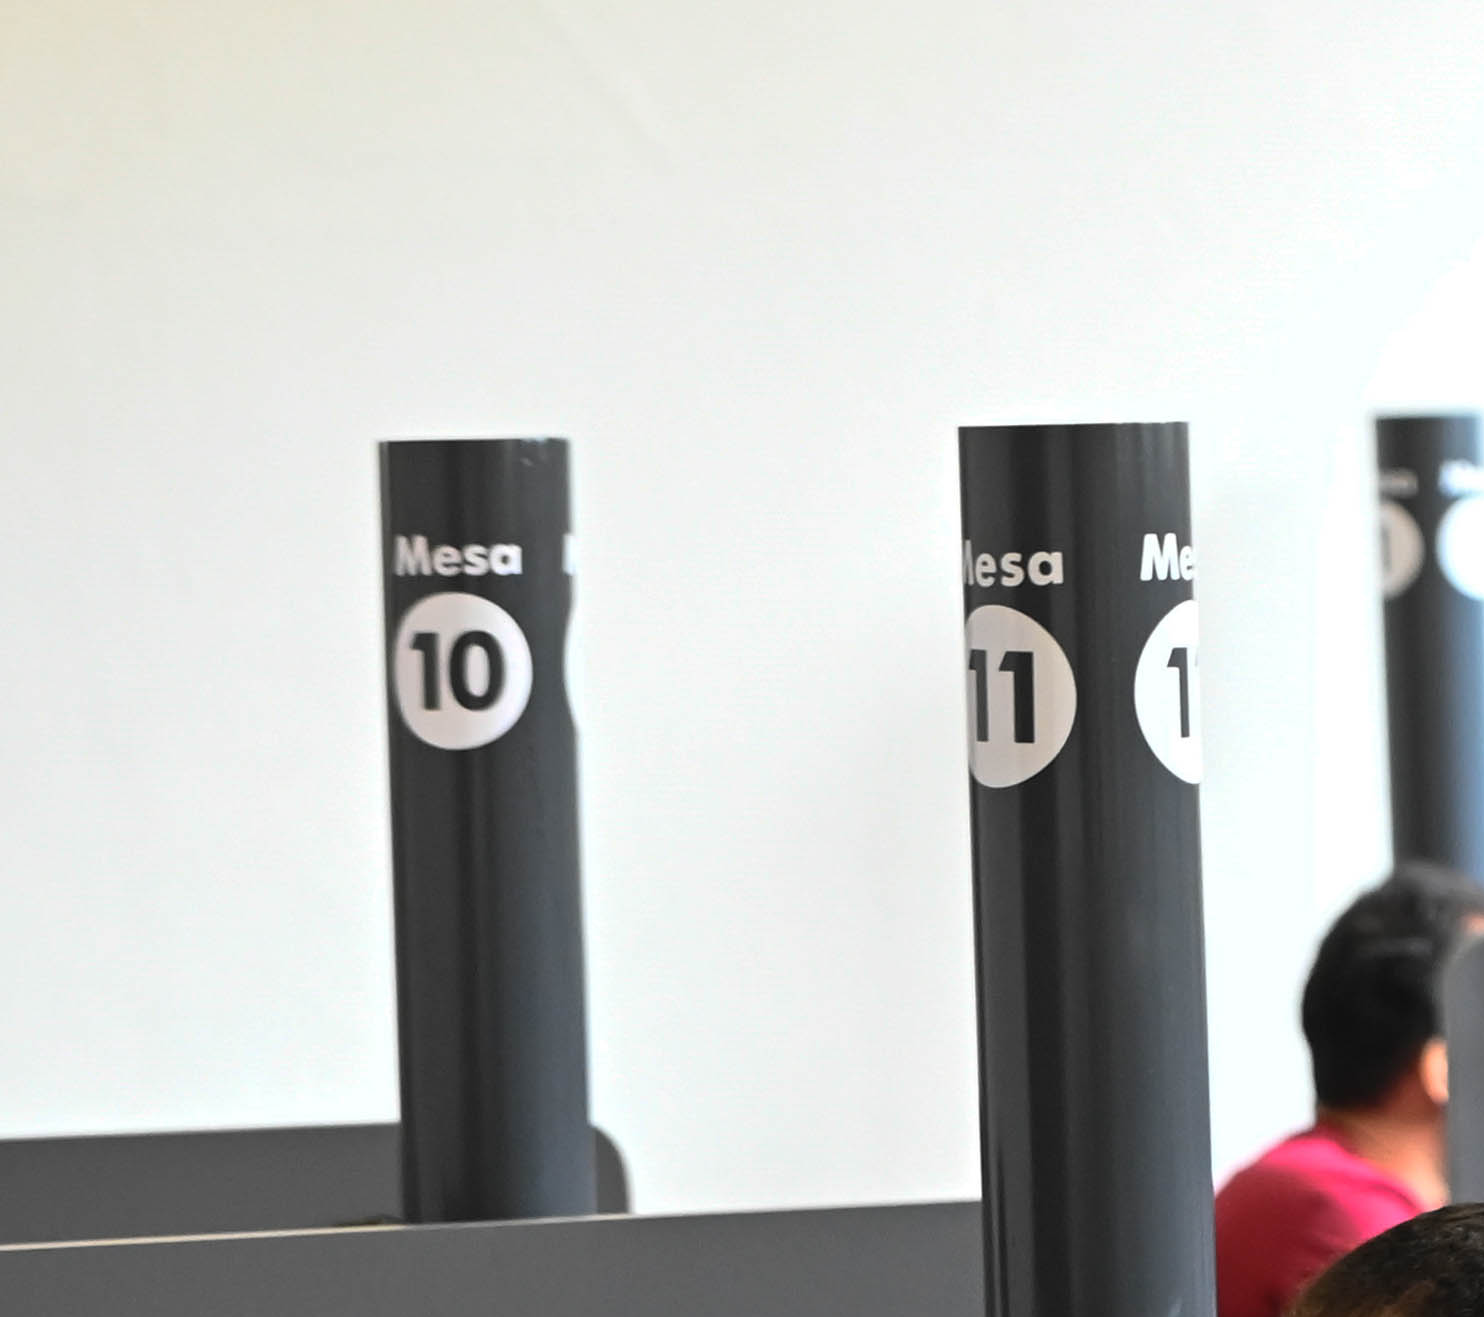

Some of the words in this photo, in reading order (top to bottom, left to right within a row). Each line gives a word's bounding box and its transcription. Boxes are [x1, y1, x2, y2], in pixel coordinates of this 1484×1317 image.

[395, 533, 523, 577] Mesa
[1140, 532, 1196, 582] Me
[410, 629, 506, 712] 10
[968, 647, 1036, 744] 11
[1166, 646, 1200, 738] 1
